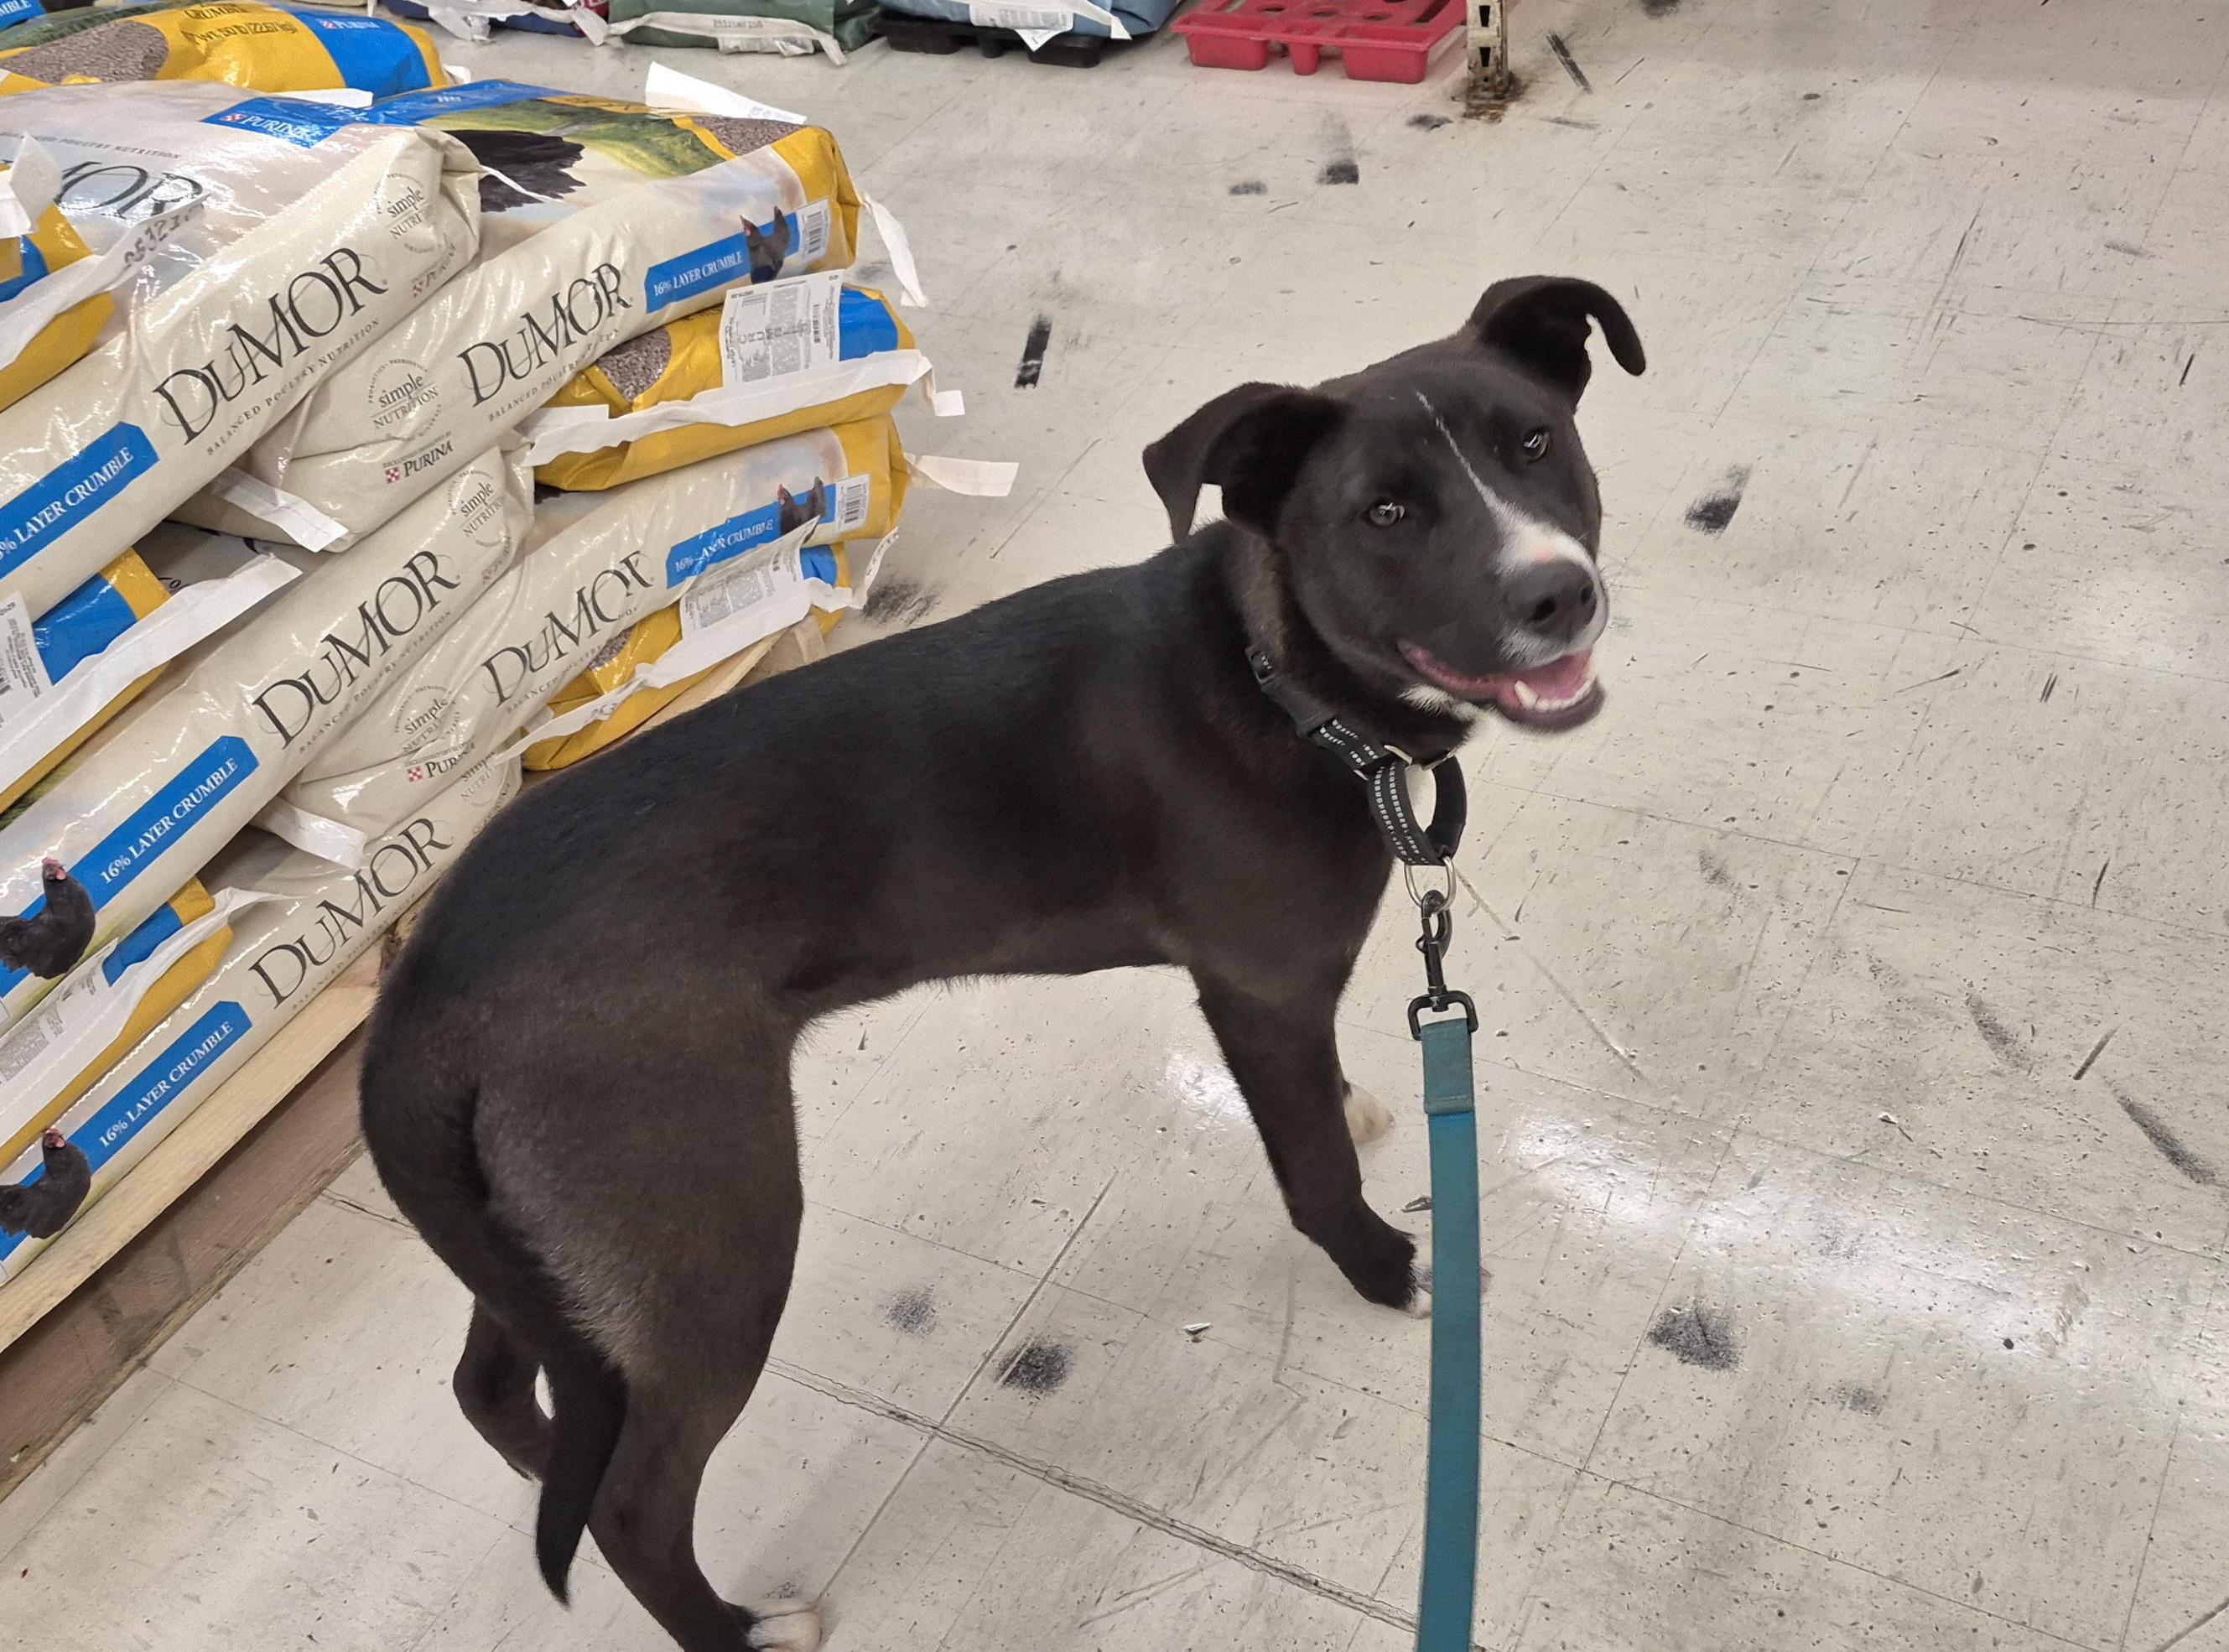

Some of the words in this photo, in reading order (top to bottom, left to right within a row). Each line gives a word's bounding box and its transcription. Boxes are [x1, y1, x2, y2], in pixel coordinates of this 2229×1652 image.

[387, 186, 424, 218] simple
[673, 268, 702, 289] LAYER
[701, 251, 744, 278] CRUMBLE
[378, 372, 423, 408] simple
[403, 439, 454, 478] PURINA
[13, 501, 67, 544] LAYER
[65, 446, 134, 507] CRUMBLE
[460, 482, 495, 517] simple
[726, 518, 774, 546] CRUMBLE
[404, 698, 449, 735] simple
[100, 854, 132, 885] 16%
[127, 815, 177, 860] LAYER
[173, 757, 239, 820] CRUMBLE
[98, 1119, 128, 1148] 16%
[127, 1079, 172, 1122] LAYER
[169, 1021, 234, 1083] CRUMBLE
